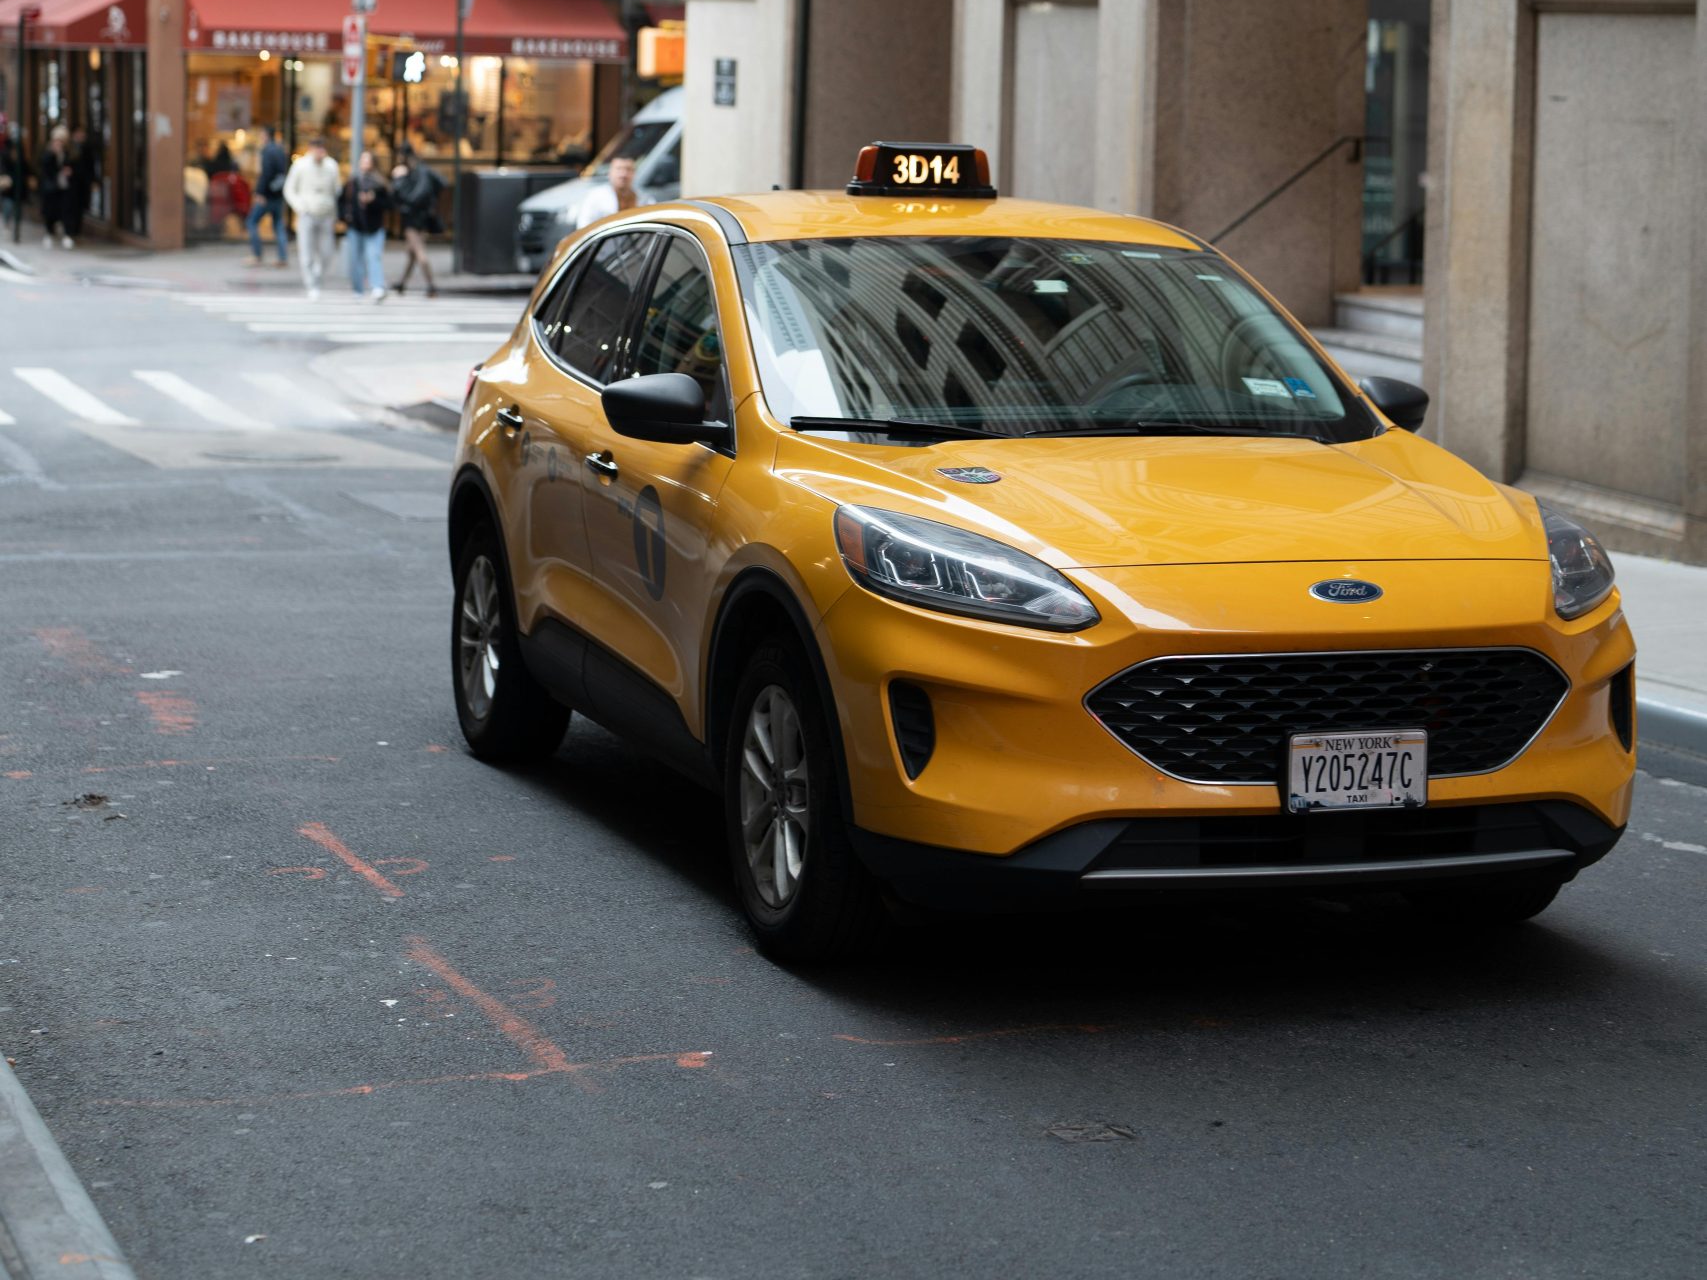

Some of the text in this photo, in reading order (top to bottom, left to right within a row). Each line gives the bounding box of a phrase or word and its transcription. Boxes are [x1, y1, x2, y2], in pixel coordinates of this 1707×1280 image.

[212, 30, 328, 51] BAKEHOUSE
[892, 154, 961, 184] 3D14
[1328, 582, 1368, 597] Ford
[1325, 736, 1392, 751] NEW YORK
[1302, 752, 1413, 793] Y205247C
[1346, 794, 1368, 803] TAXI
